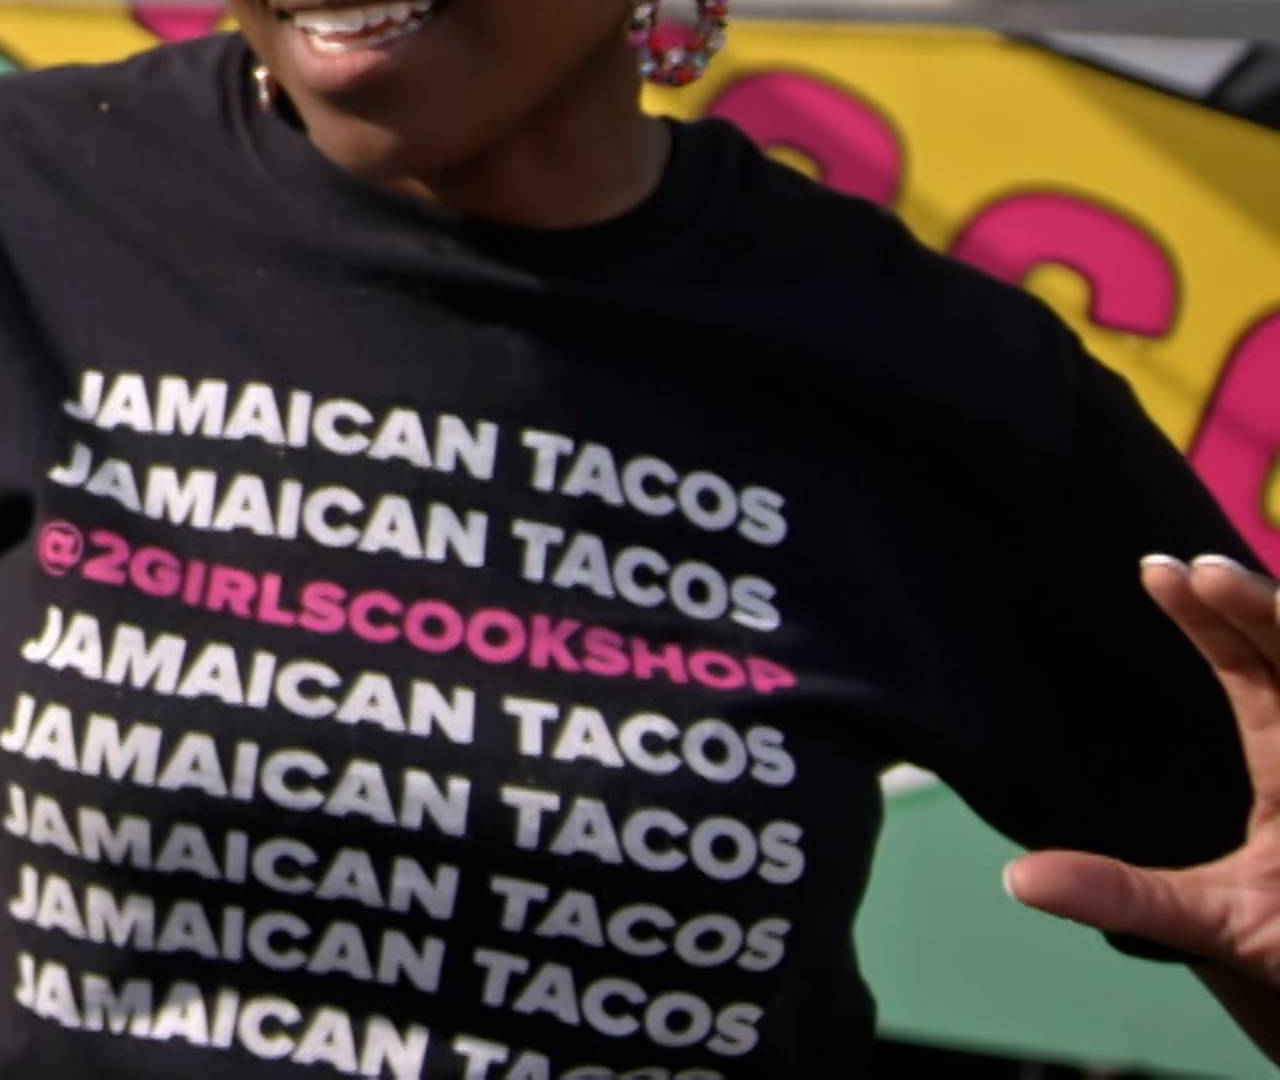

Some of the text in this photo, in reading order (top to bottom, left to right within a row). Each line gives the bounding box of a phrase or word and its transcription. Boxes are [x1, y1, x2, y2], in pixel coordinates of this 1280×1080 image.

[46, 438, 782, 633] JAMAICAN TACOS
[61, 367, 789, 547] JAMAICAN TACOS
[20, 604, 797, 788] JAMAICAN TACOS
[36, 517, 799, 696] @2GIRLSCOOKSHOP
[3, 781, 793, 973] JAMAICAN TACOS
[498, 784, 807, 886] TACOS
[8, 862, 766, 1057] JAMAICAN TACOS
[13, 950, 430, 1080] JAMAICAN
